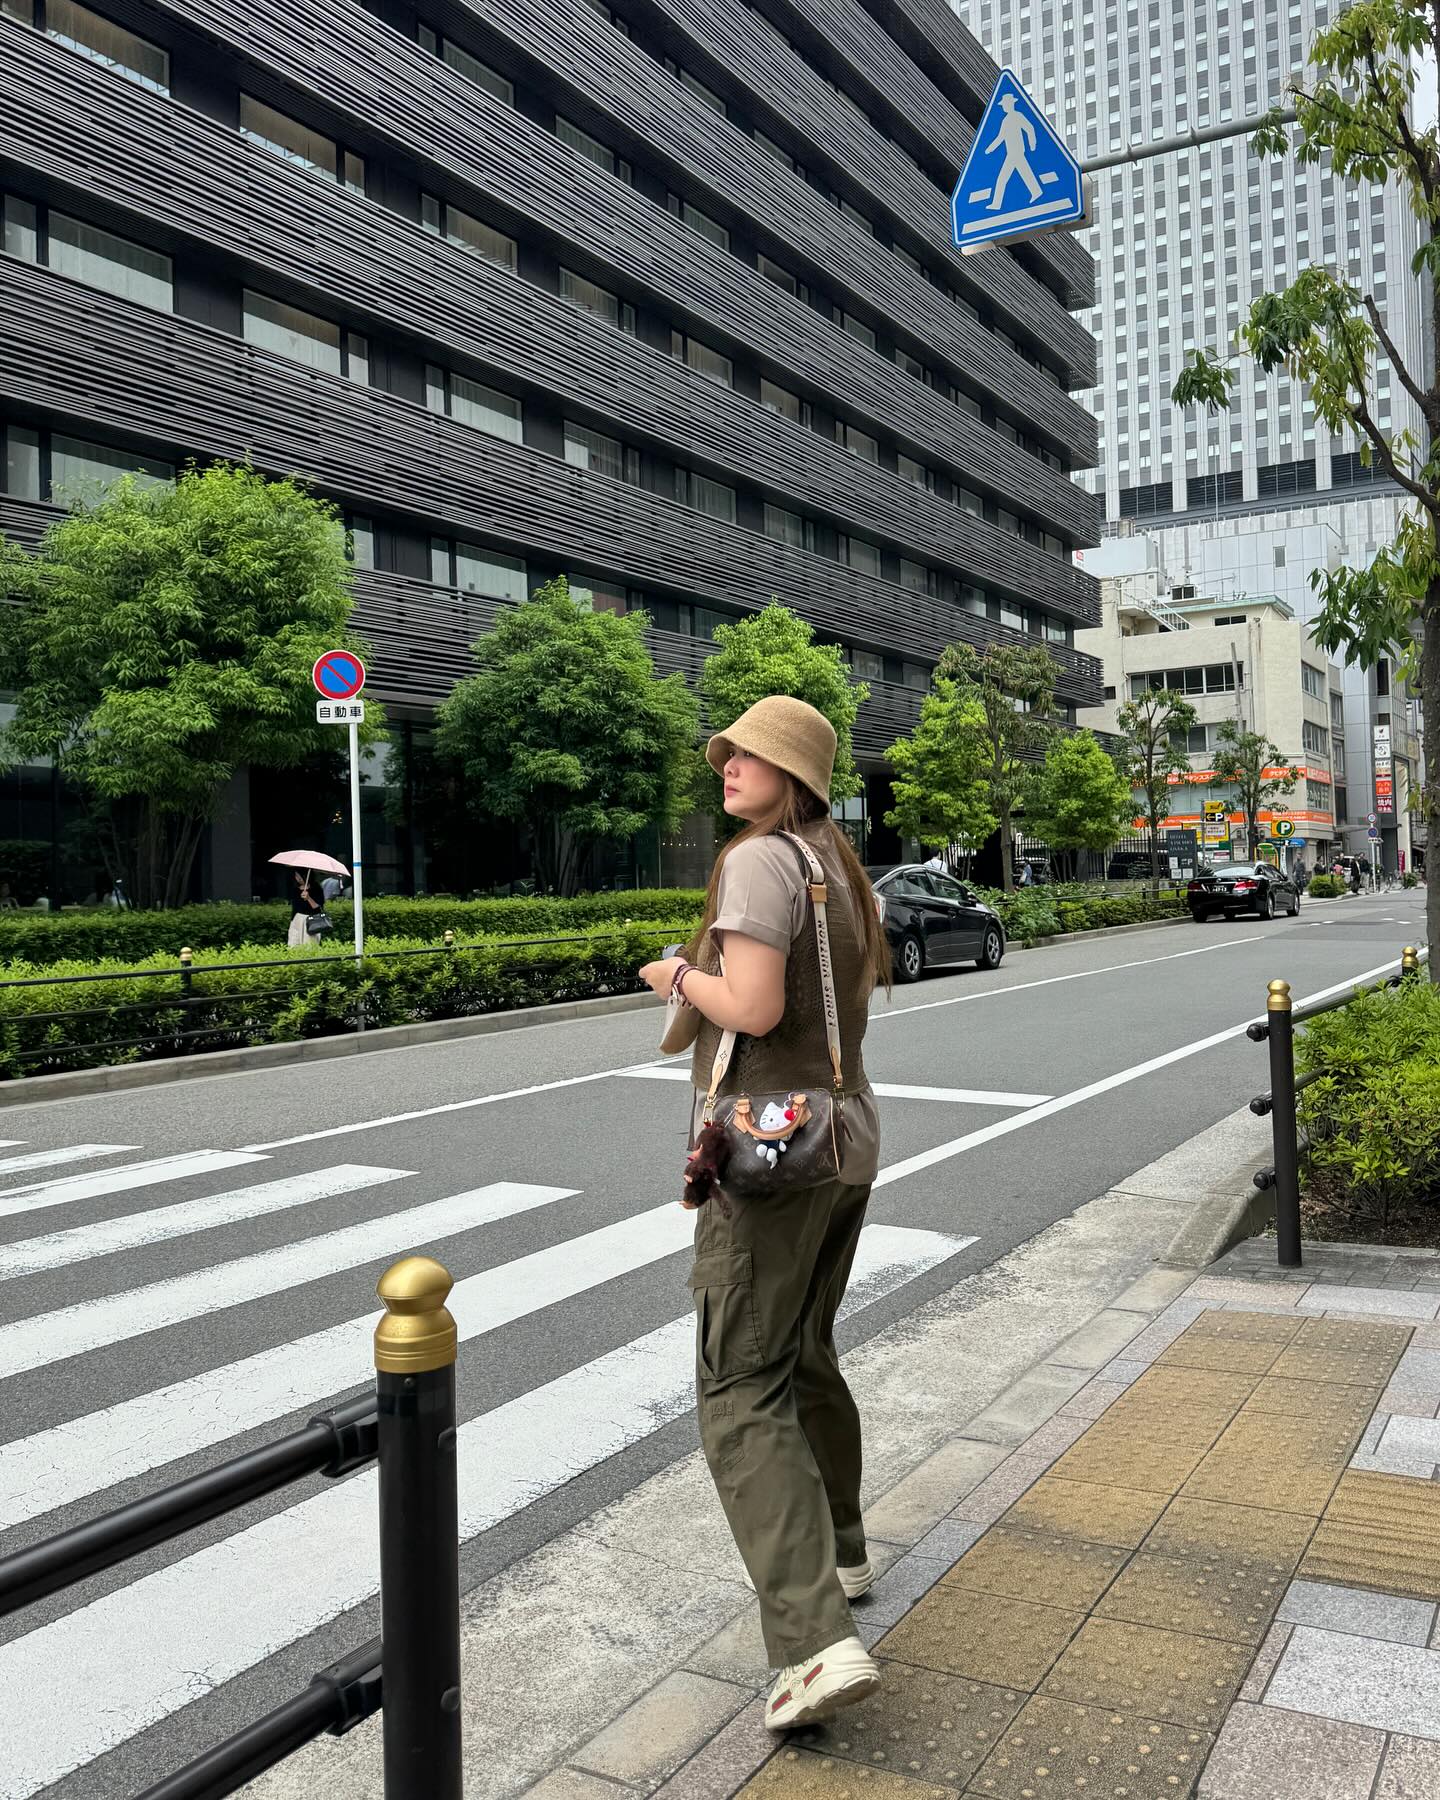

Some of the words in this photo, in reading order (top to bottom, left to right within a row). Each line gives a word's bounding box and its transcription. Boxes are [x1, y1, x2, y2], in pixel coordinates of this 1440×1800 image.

[320, 706, 361, 718] 自動車
[1215, 813, 1223, 822] P
[1280, 822, 1291, 834] P
